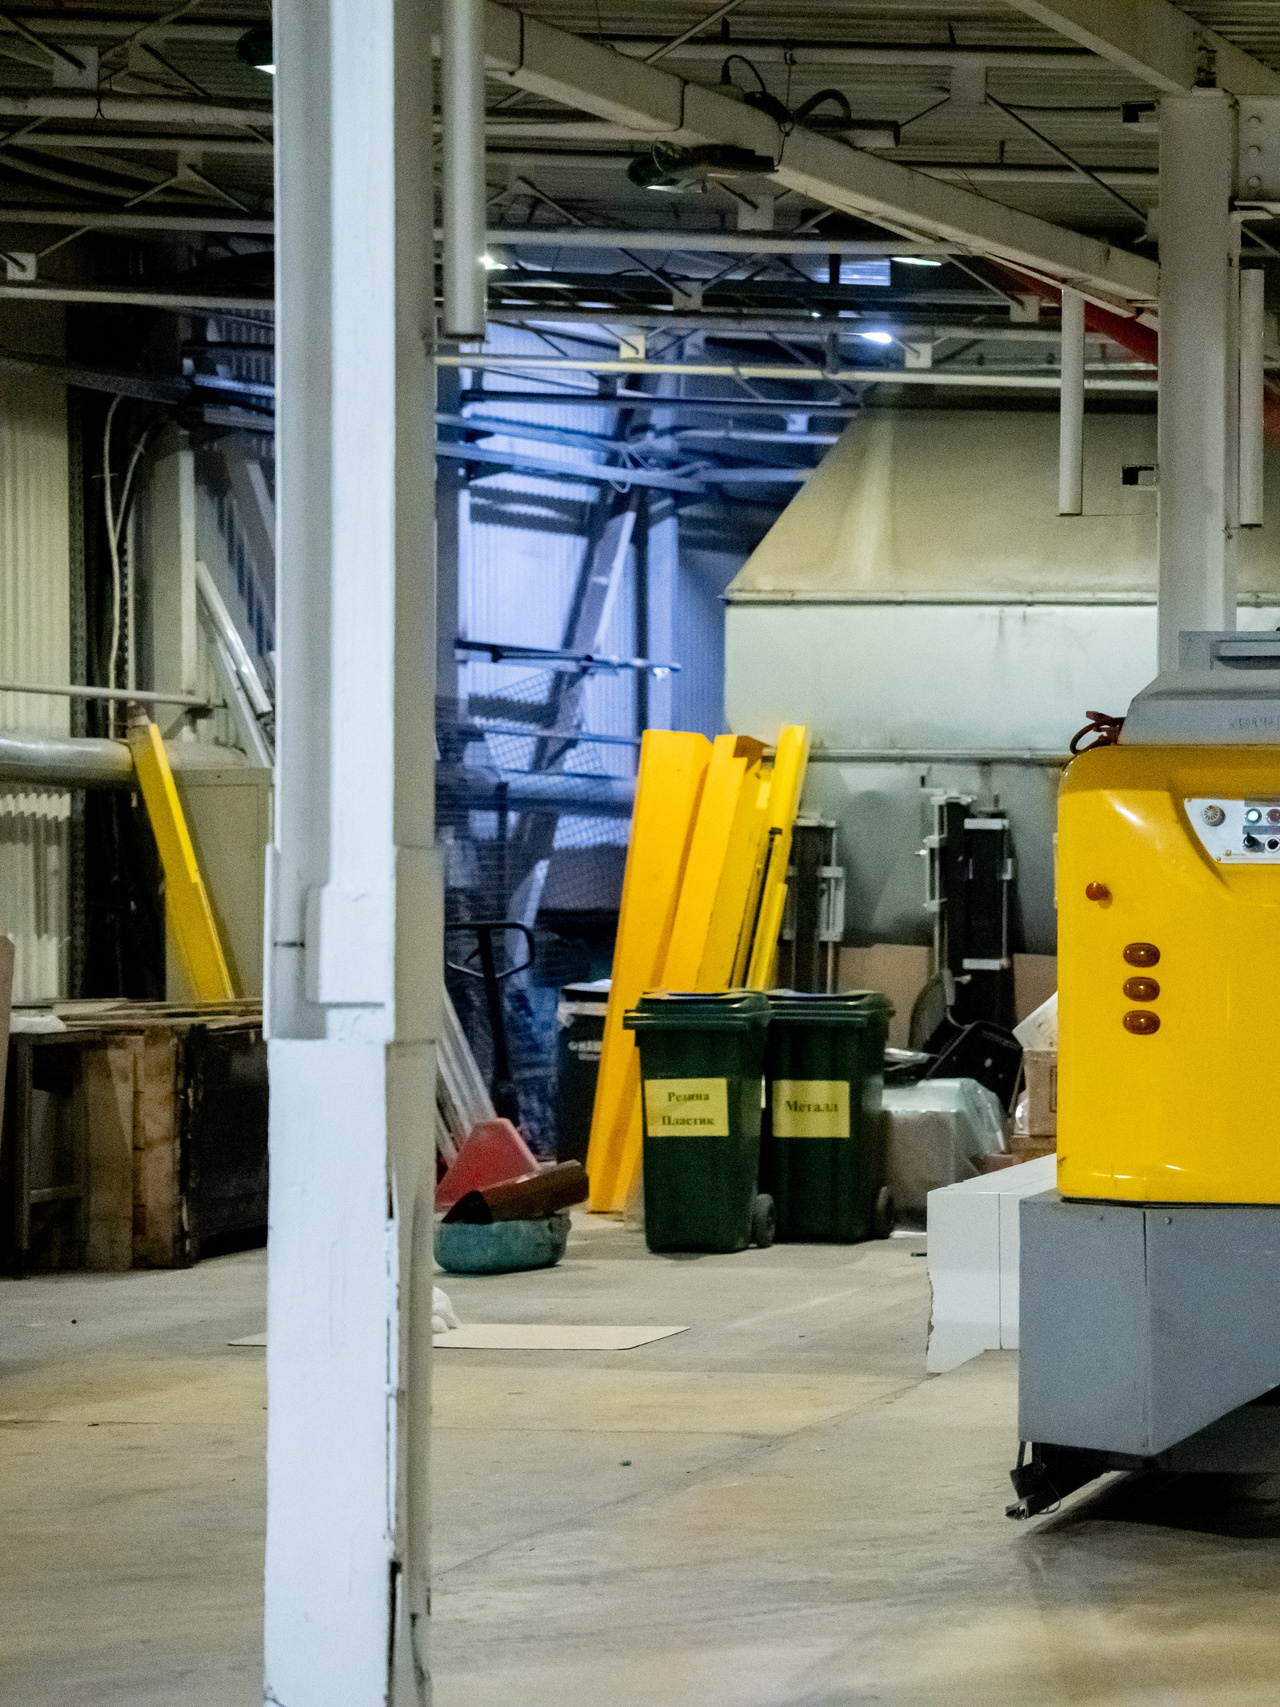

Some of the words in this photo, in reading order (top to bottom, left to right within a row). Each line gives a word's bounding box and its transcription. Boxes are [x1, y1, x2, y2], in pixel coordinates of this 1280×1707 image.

[668, 1091, 710, 1102] Резина
[785, 1100, 838, 1113] Металл
[662, 1115, 715, 1126] Пластик
